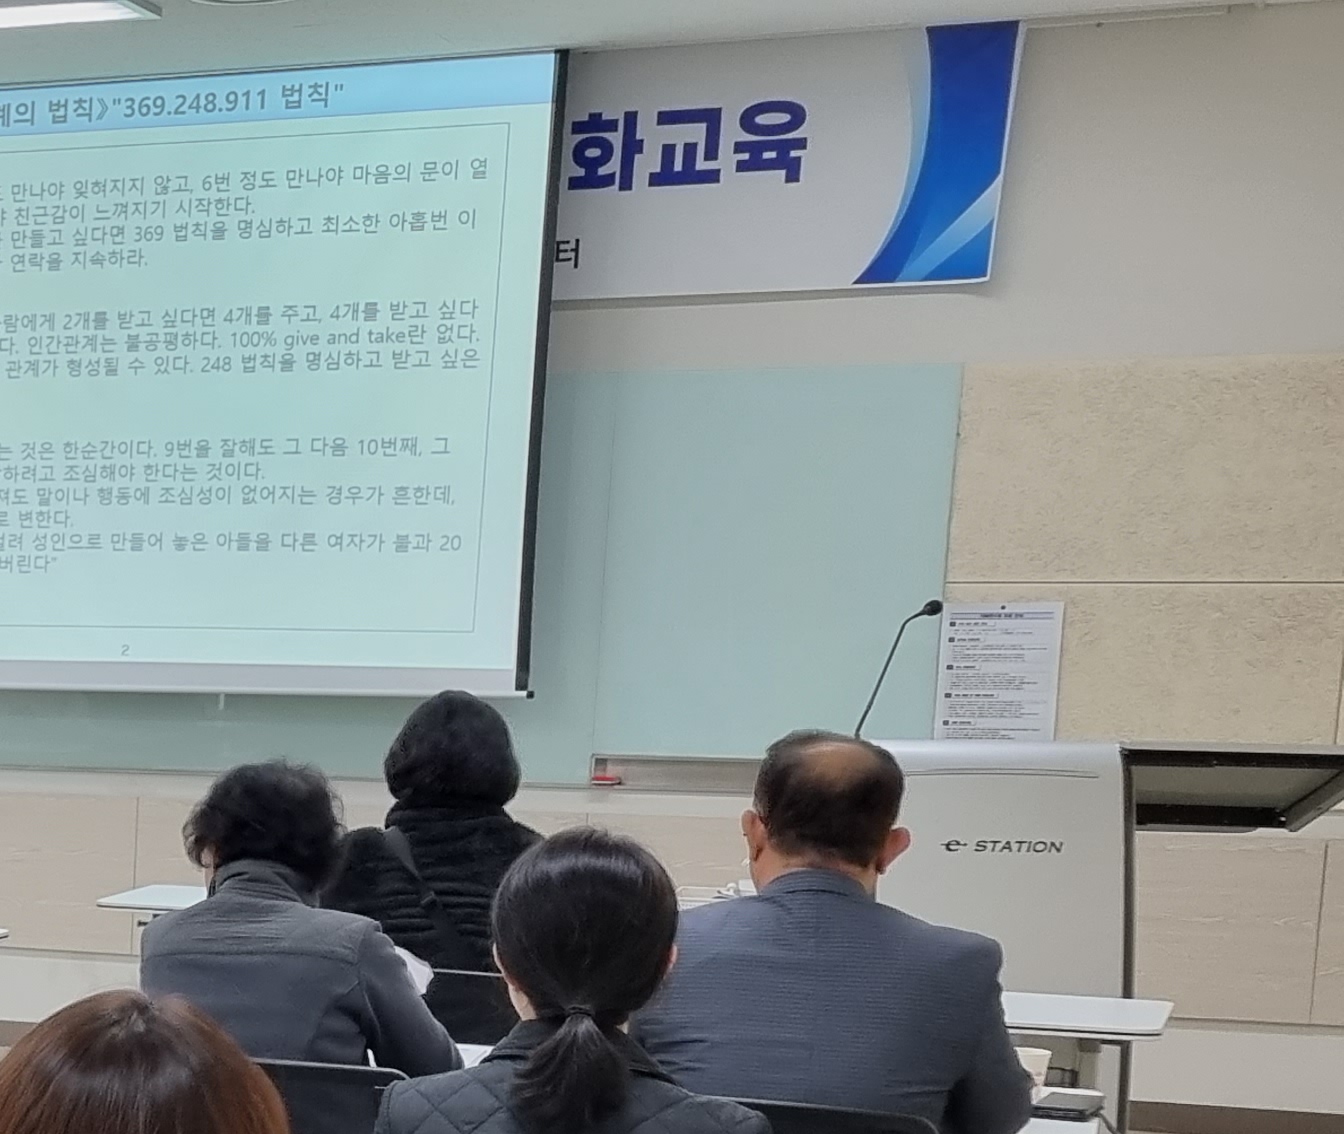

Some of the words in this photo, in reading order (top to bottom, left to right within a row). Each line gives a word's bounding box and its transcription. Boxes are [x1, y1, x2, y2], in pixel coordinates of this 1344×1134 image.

[567, 99, 809, 192] 화교육
[10, 180, 65, 204] 만나야
[72, 175, 145, 200] 잊혀지지
[152, 172, 195, 196] 않고,
[201, 171, 232, 194] 6번
[238, 168, 279, 192] 정도
[284, 164, 345, 190] 만나야
[351, 161, 412, 186] 마음의
[418, 158, 459, 183] 문이
[468, 156, 489, 180] 열
[13, 202, 85, 227] 친근감이
[92, 198, 166, 223] 느껴지기
[174, 194, 256, 219] 시작한다.
[9, 226, 65, 250] 만들고
[71, 223, 127, 247] 싶다면
[133, 223, 165, 243] 369
[172, 219, 229, 243] 법칙을
[236, 215, 314, 240] 명심하고
[320, 212, 382, 236] 최소한
[387, 208, 449, 233] 아홉번
[456, 207, 477, 230] 이
[9, 250, 64, 273] 연락을
[70, 246, 148, 270] 지속하라.
[62, 310, 110, 332] 2개를
[116, 308, 155, 330] 받고
[160, 306, 217, 329] 싶다면
[222, 304, 274, 327] 4개를
[279, 303, 324, 325] 주고,
[328, 300, 382, 323] 4개를
[388, 299, 431, 322] 받고
[436, 297, 480, 321] 싶다
[26, 332, 119, 356] 인간관계는
[123, 329, 223, 353] 불공평하다.
[229, 329, 278, 349] 100%
[282, 328, 321, 351] give
[326, 325, 361, 345] and
[366, 323, 428, 346] take란
[434, 321, 481, 345] 없다.
[4, 357, 60, 380] 관계가
[65, 355, 119, 378] 형성될
[126, 356, 147, 376] 수
[152, 353, 195, 375] 있다.
[200, 355, 233, 373] 248
[240, 351, 298, 374] 법칙을
[304, 348, 384, 372] 명심하고
[390, 347, 433, 370] 받고
[439, 346, 482, 370] 싶은
[19, 440, 56, 461] 것은
[61, 438, 158, 461] 한순간이다.
[163, 437, 213, 459] 9번을
[218, 437, 277, 458] 잘해도
[281, 437, 303, 455] 그
[309, 435, 350, 457] 다음
[356, 435, 423, 458] 10번째,
[429, 436, 452, 455] 그
[61, 462, 136, 484] 조심해야
[142, 461, 199, 483] 한다는
[205, 460, 266, 482] 것이다.
[35, 486, 91, 507] 말이나
[95, 485, 150, 506] 행동에
[157, 484, 232, 506] 조심성이
[240, 483, 318, 506] 없어지는
[324, 484, 386, 506] 경우가
[390, 484, 456, 506] 흔한데,
[17, 508, 74, 529] 변한다.
[31, 531, 104, 552] 성인으로
[109, 531, 164, 552] 만들어
[170, 531, 210, 552] 놓은
[215, 530, 273, 552] 아들을
[279, 531, 319, 553] 다른
[326, 531, 387, 553] 여자가
[391, 532, 433, 553] 불과
[438, 534, 462, 552] 20
[120, 643, 131, 657] 2
[974, 839, 1064, 854] STATION
